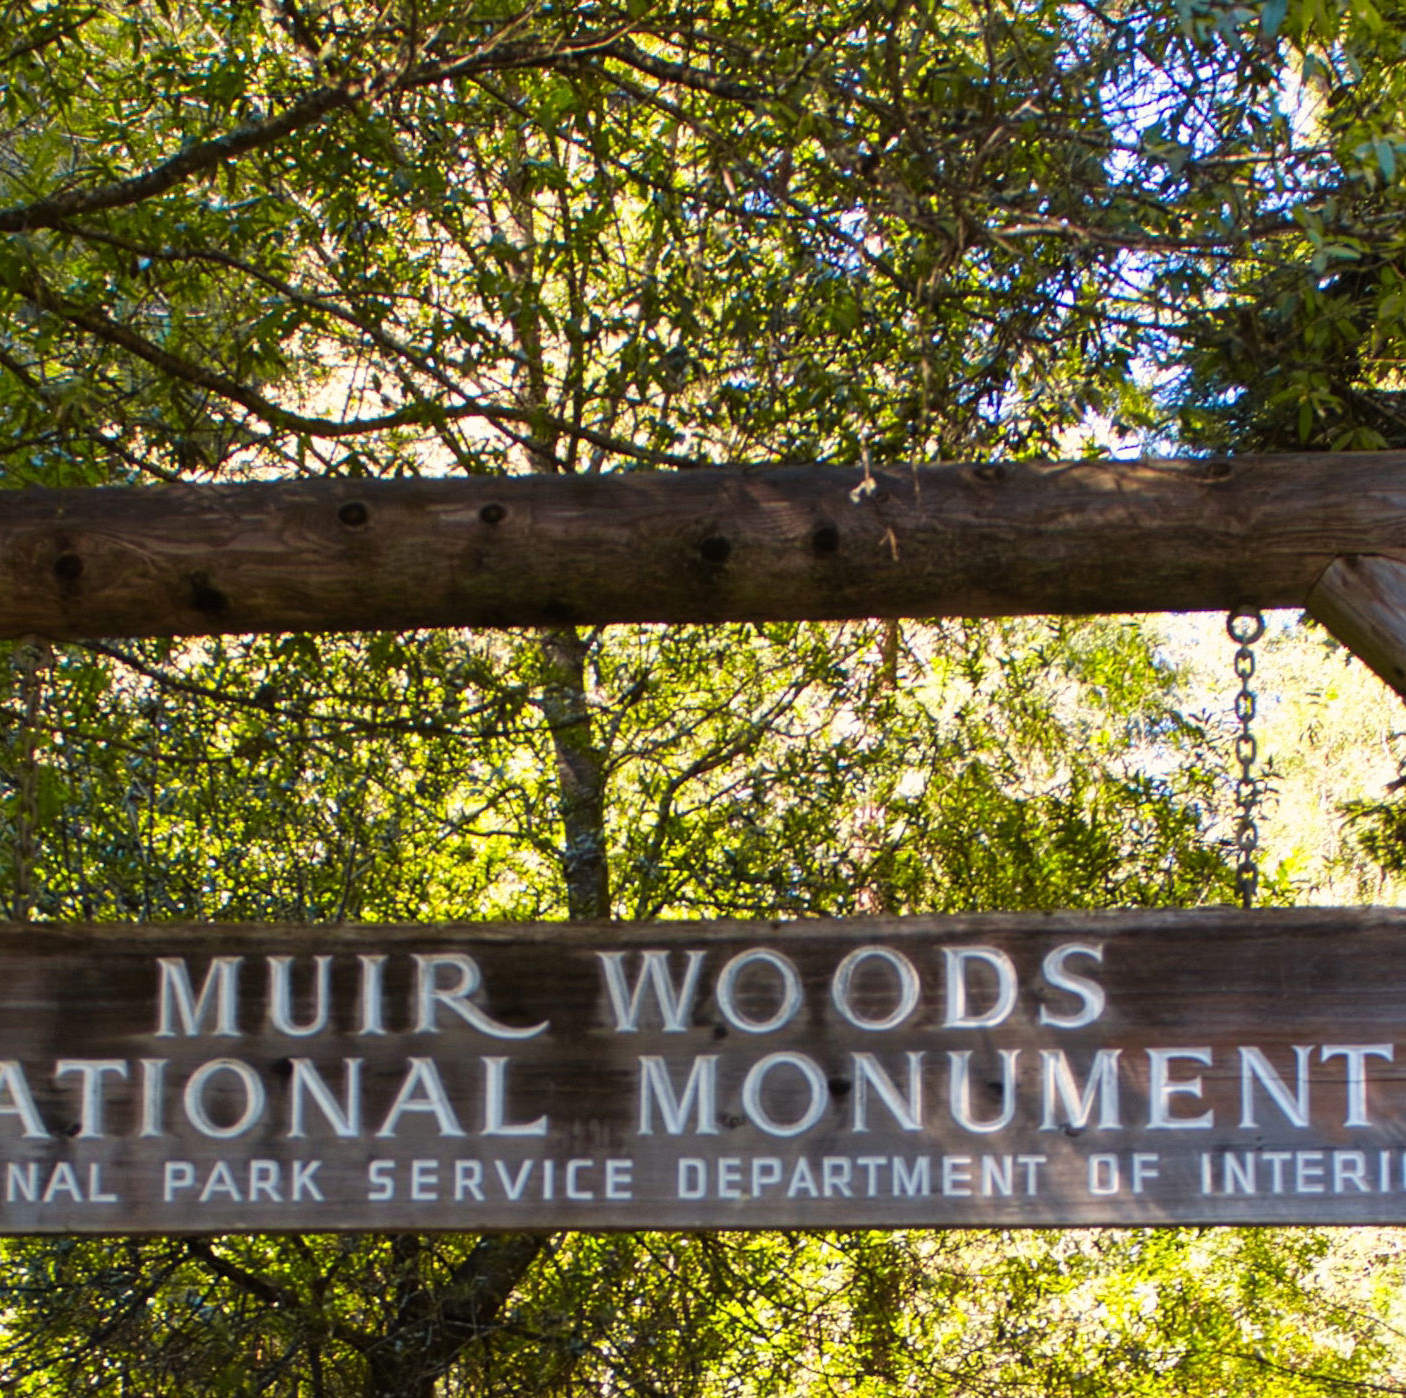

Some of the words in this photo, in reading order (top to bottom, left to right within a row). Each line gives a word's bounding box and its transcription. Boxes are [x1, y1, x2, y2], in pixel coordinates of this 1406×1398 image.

[154, 952, 550, 1039] MUIR
[596, 941, 1106, 1034] WOODS
[636, 1043, 1394, 1137] MONUMENT
[163, 1159, 324, 1202] PARK
[367, 1157, 634, 1201] SERVICE
[678, 1153, 1048, 1199] DEPARTMENT
[1088, 1152, 1160, 1196] OF
